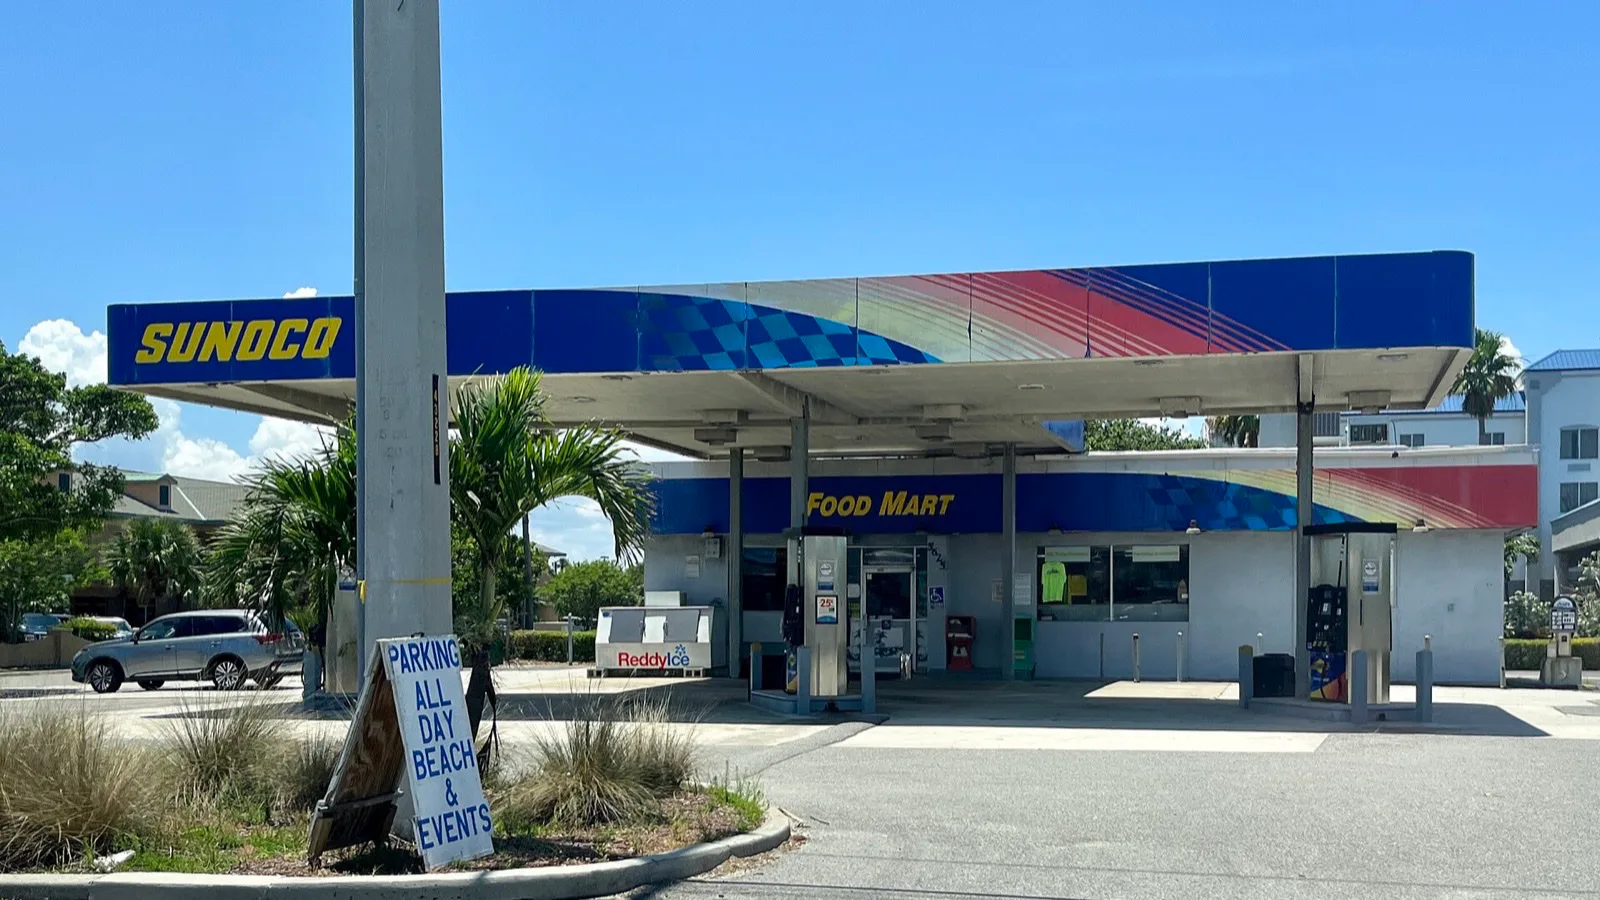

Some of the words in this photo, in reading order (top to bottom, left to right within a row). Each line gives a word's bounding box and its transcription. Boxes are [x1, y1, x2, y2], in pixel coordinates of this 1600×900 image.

[135, 317, 342, 364] SUNOCO
[807, 492, 872, 517] FOOD
[879, 491, 955, 516] MART
[389, 639, 460, 674] PARKING
[415, 678, 452, 711] ALL
[419, 710, 455, 744] DAY
[413, 739, 475, 780] BEACH
[445, 777, 458, 807] &
[417, 804, 492, 850] EVENTS
